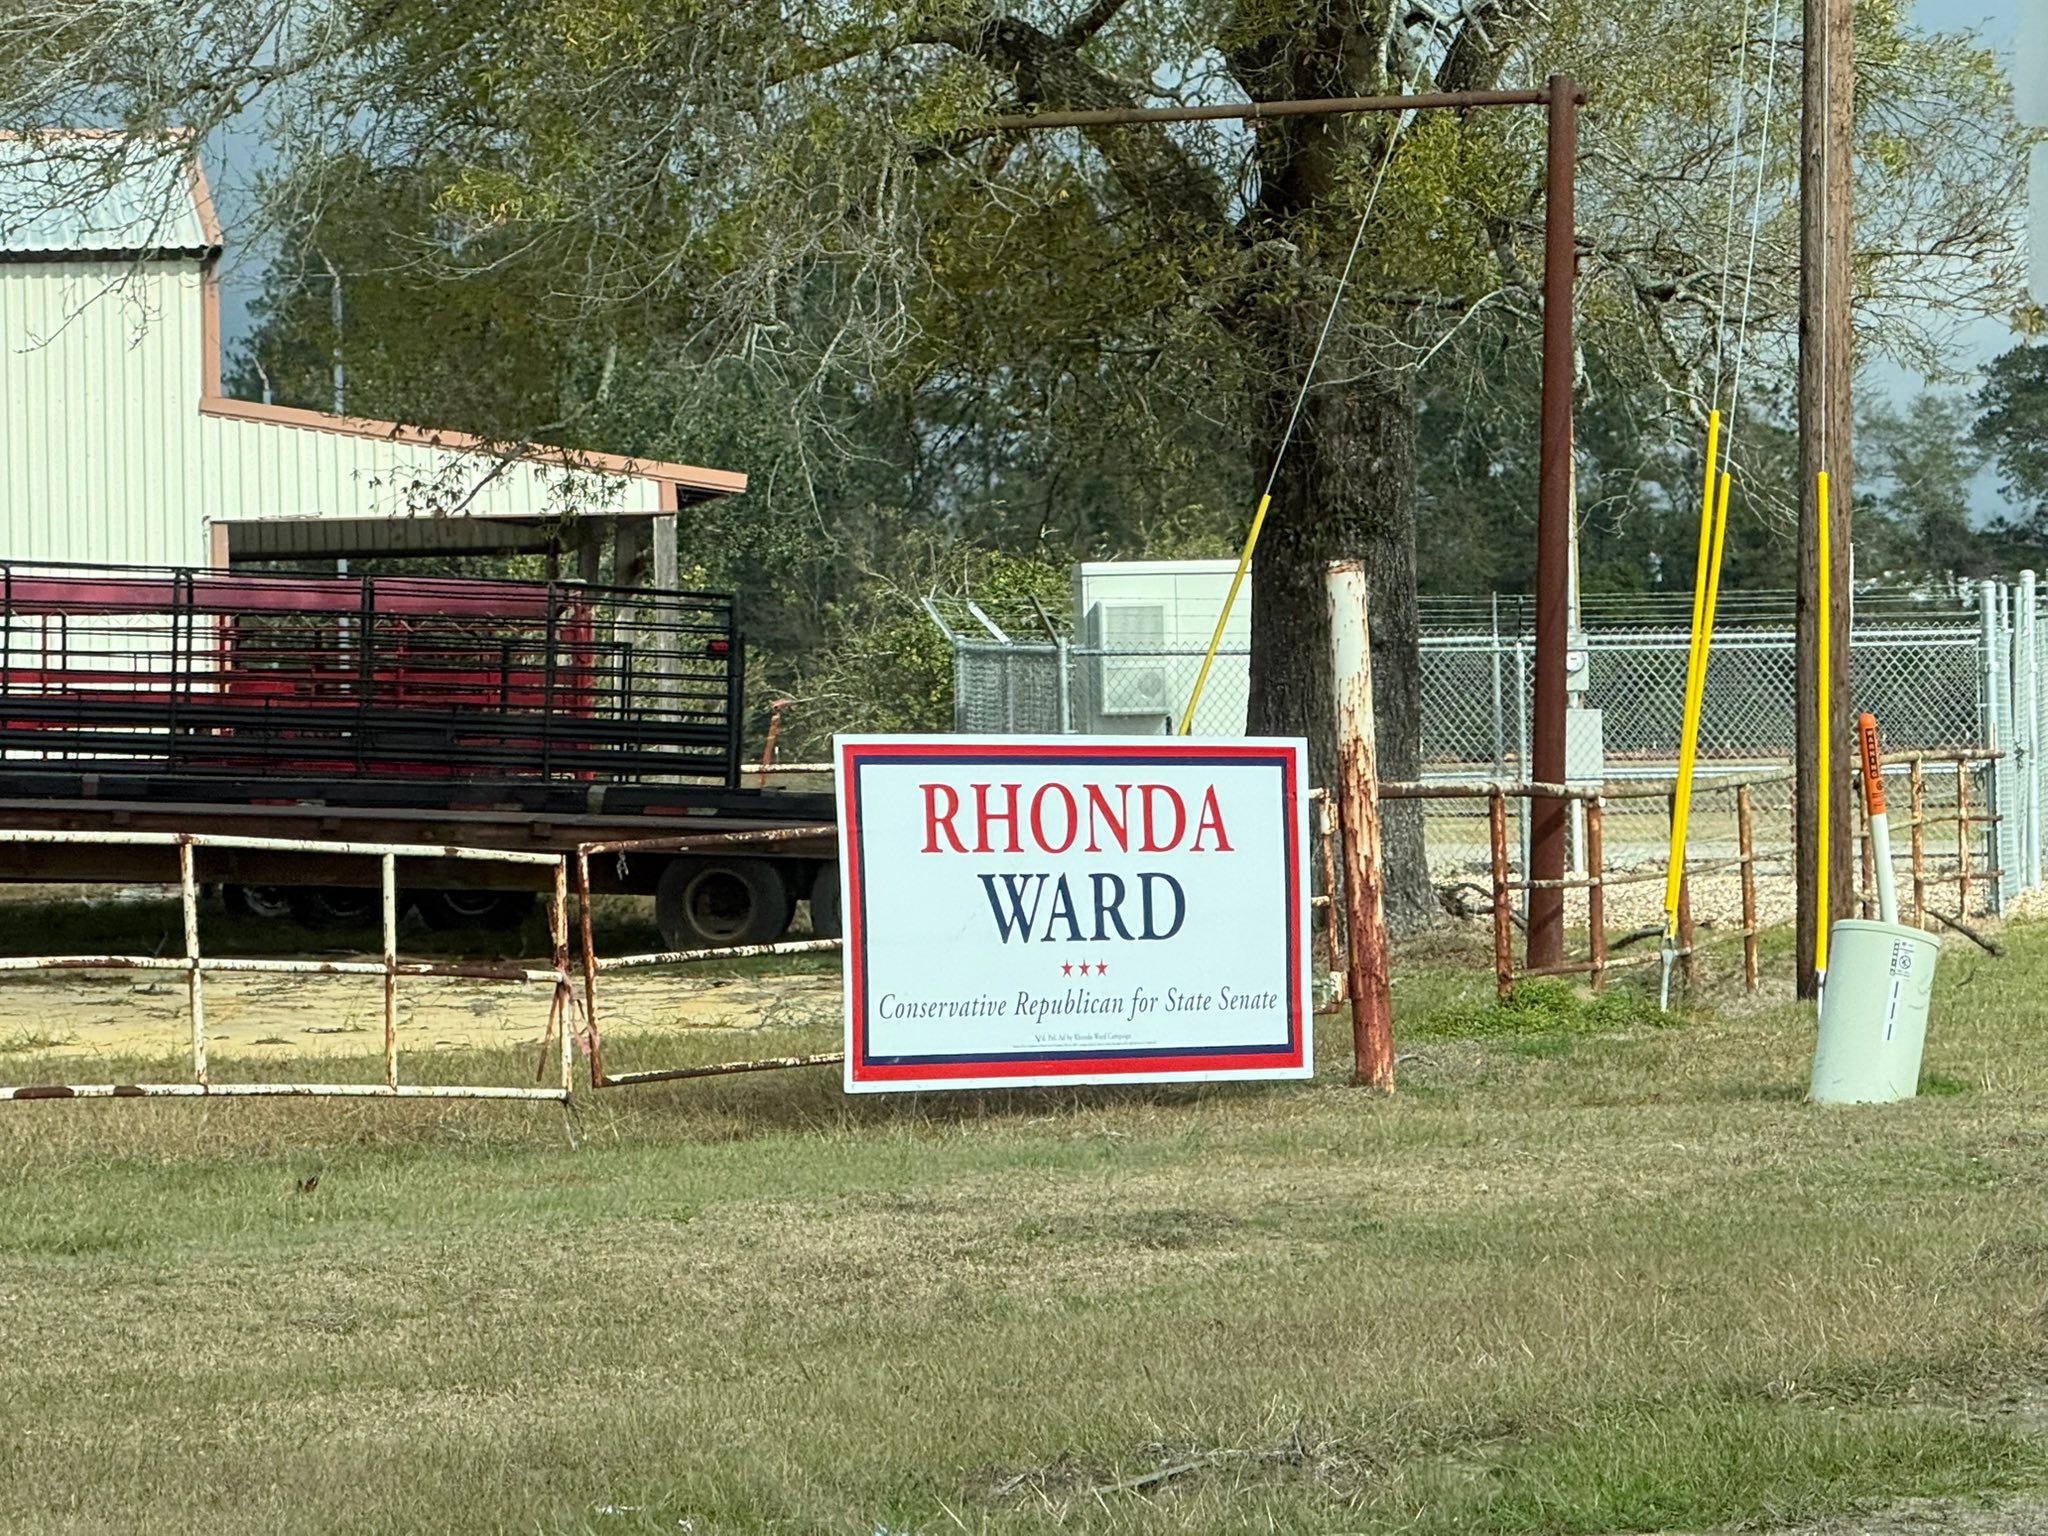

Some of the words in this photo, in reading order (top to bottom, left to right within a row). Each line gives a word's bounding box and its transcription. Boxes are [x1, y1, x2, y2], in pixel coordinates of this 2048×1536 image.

[919, 782, 1234, 854] RHONDA
[977, 871, 1187, 944] WARD
[879, 993, 1007, 1019] Conservative
[1014, 988, 1123, 1024] Republican
[1127, 987, 1159, 1021] for
[1165, 987, 1212, 1012] State
[1218, 986, 1278, 1010] Senate
